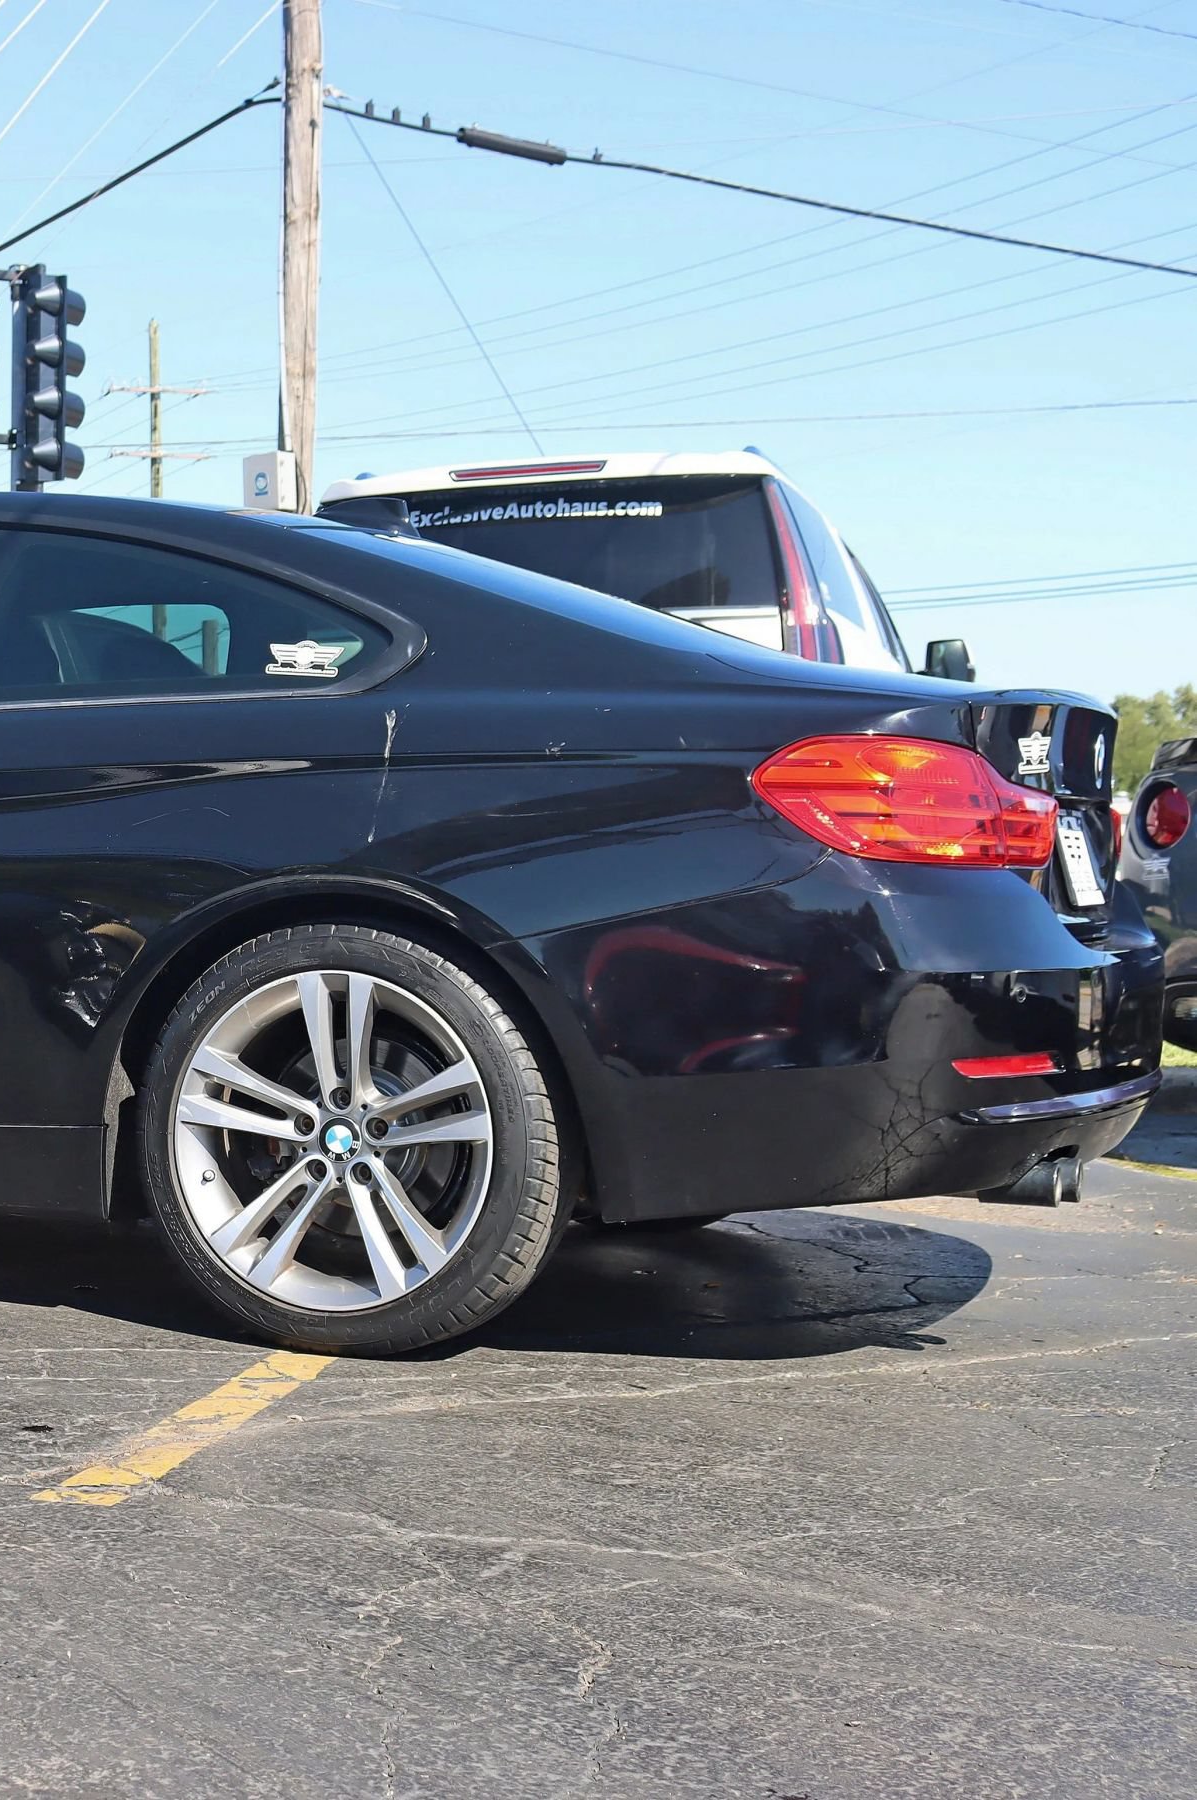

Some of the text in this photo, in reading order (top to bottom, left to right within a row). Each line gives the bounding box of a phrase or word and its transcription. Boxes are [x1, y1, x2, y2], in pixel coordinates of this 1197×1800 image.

[409, 498, 664, 528] ExclusiveAutohaus.com
[188, 981, 226, 1025] ZEON
[327, 1140, 360, 1161] BMW
